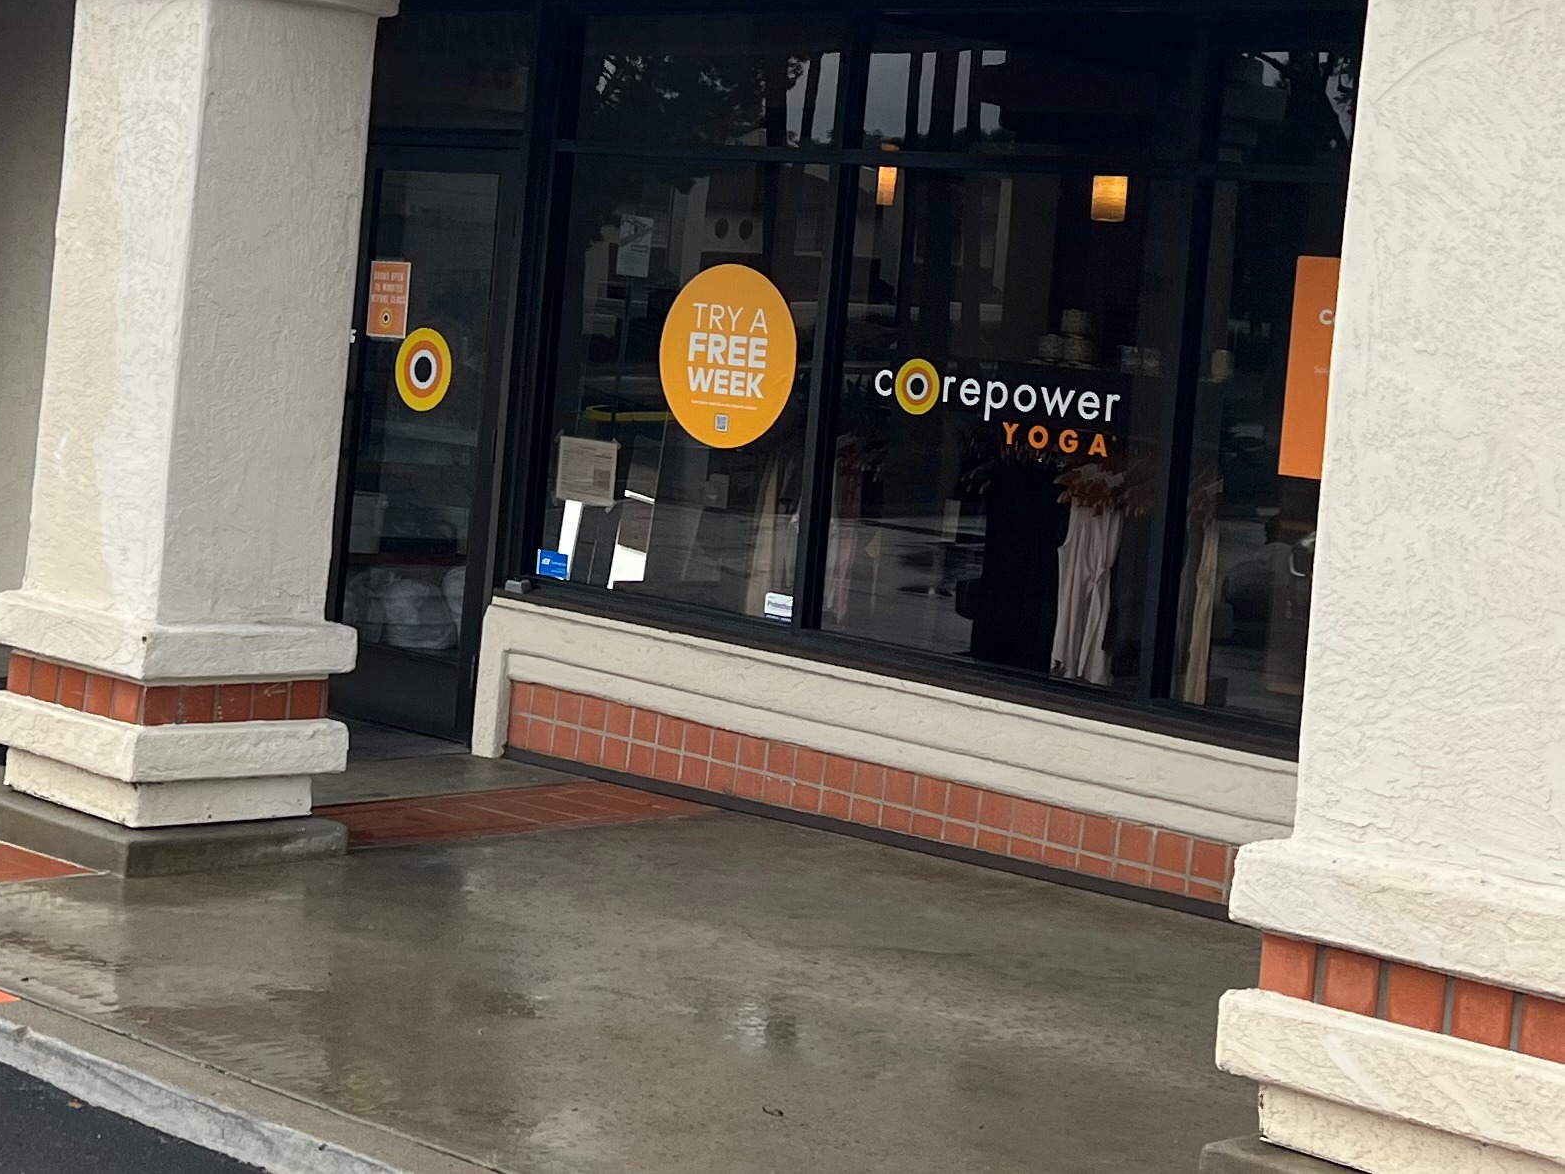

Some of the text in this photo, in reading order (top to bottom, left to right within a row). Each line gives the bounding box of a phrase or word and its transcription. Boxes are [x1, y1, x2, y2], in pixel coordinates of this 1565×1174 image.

[692, 302, 768, 334] TRY A
[688, 331, 768, 369] FREE
[687, 366, 766, 399] WEEK
[874, 358, 1121, 422] corepower
[1002, 421, 1109, 458] YOGA
